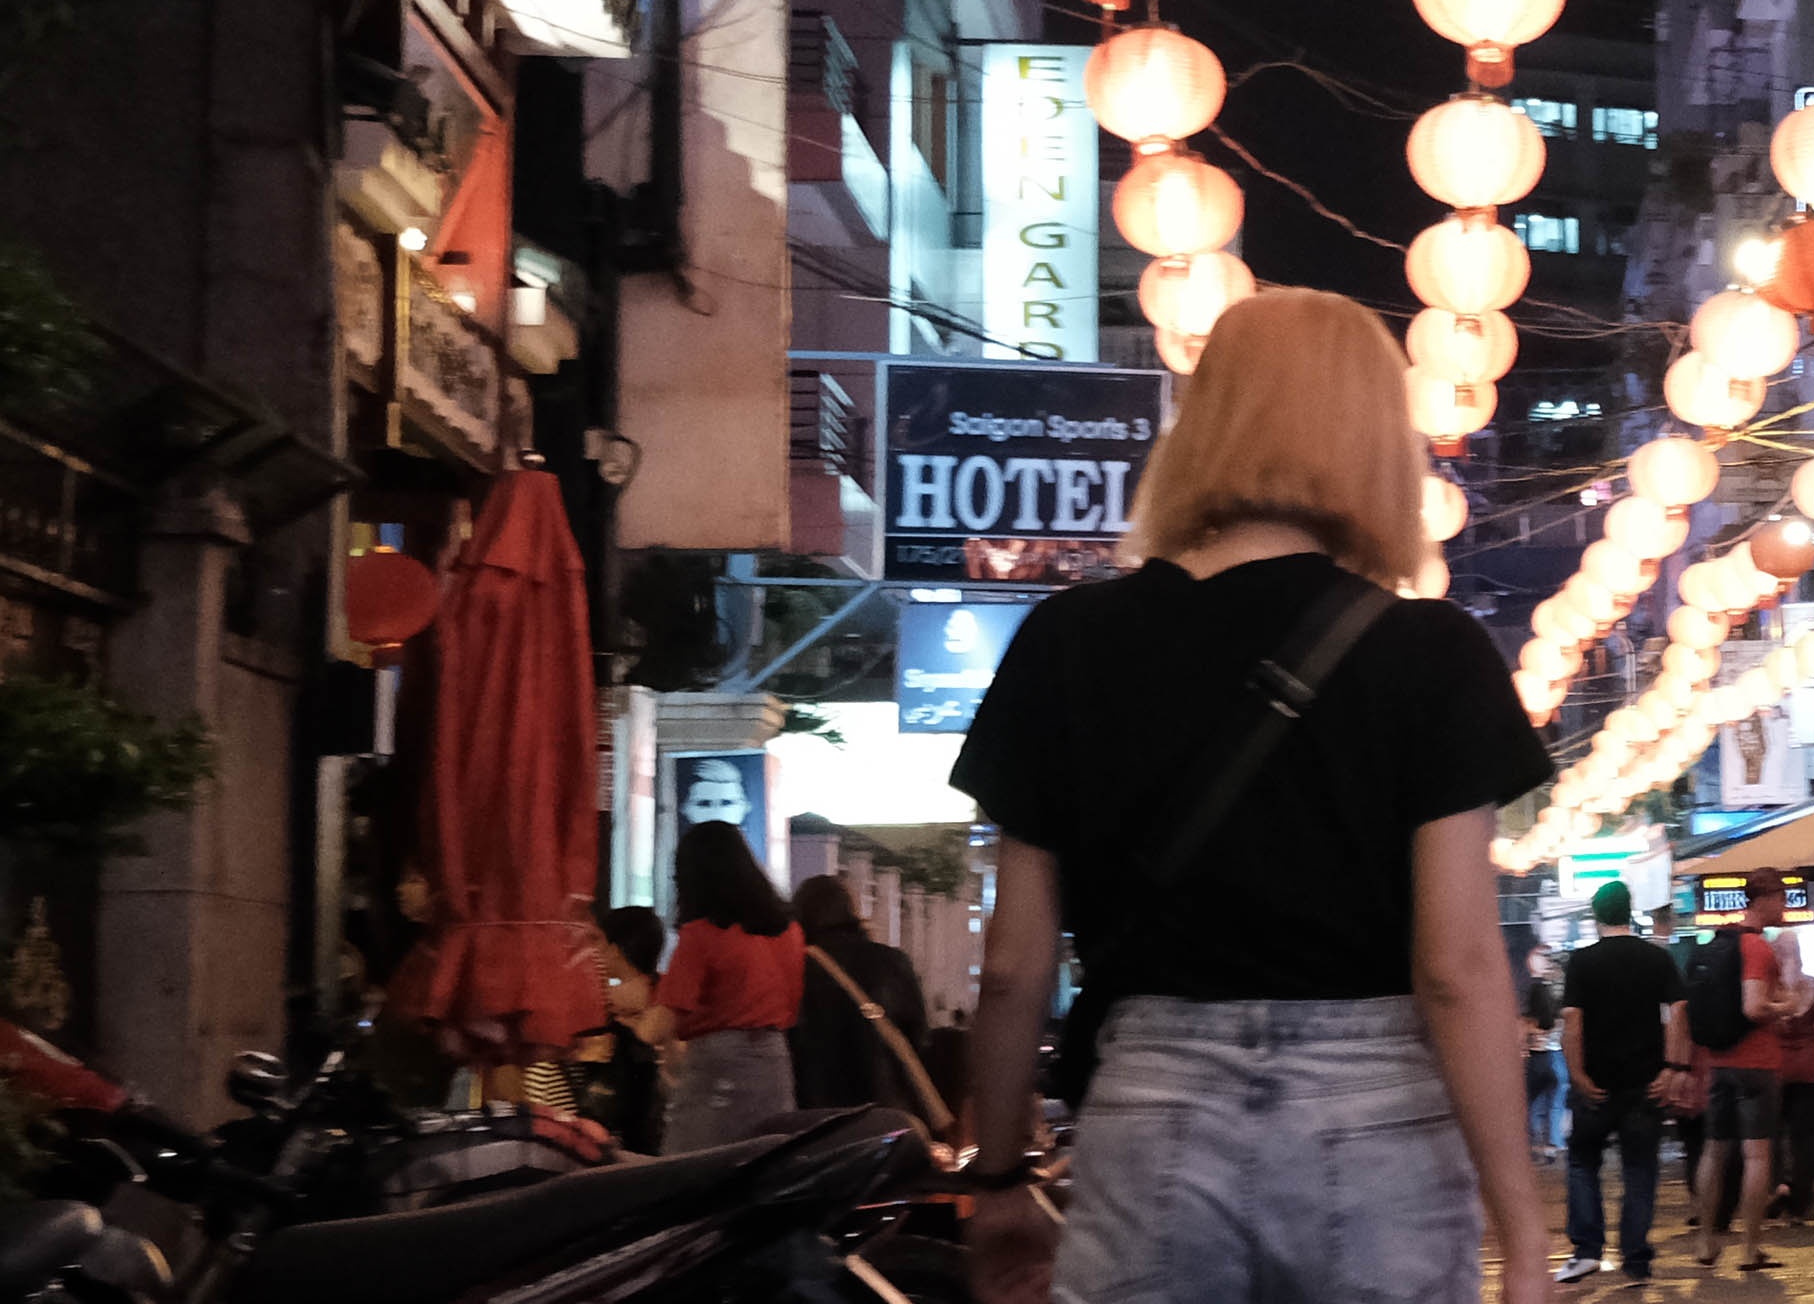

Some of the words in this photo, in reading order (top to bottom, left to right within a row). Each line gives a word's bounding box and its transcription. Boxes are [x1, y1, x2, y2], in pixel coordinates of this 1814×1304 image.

[947, 410, 1046, 443] Saigon
[1046, 413, 1130, 444] Sports
[1130, 416, 1153, 443] 3
[894, 453, 1138, 534] HOTEL
